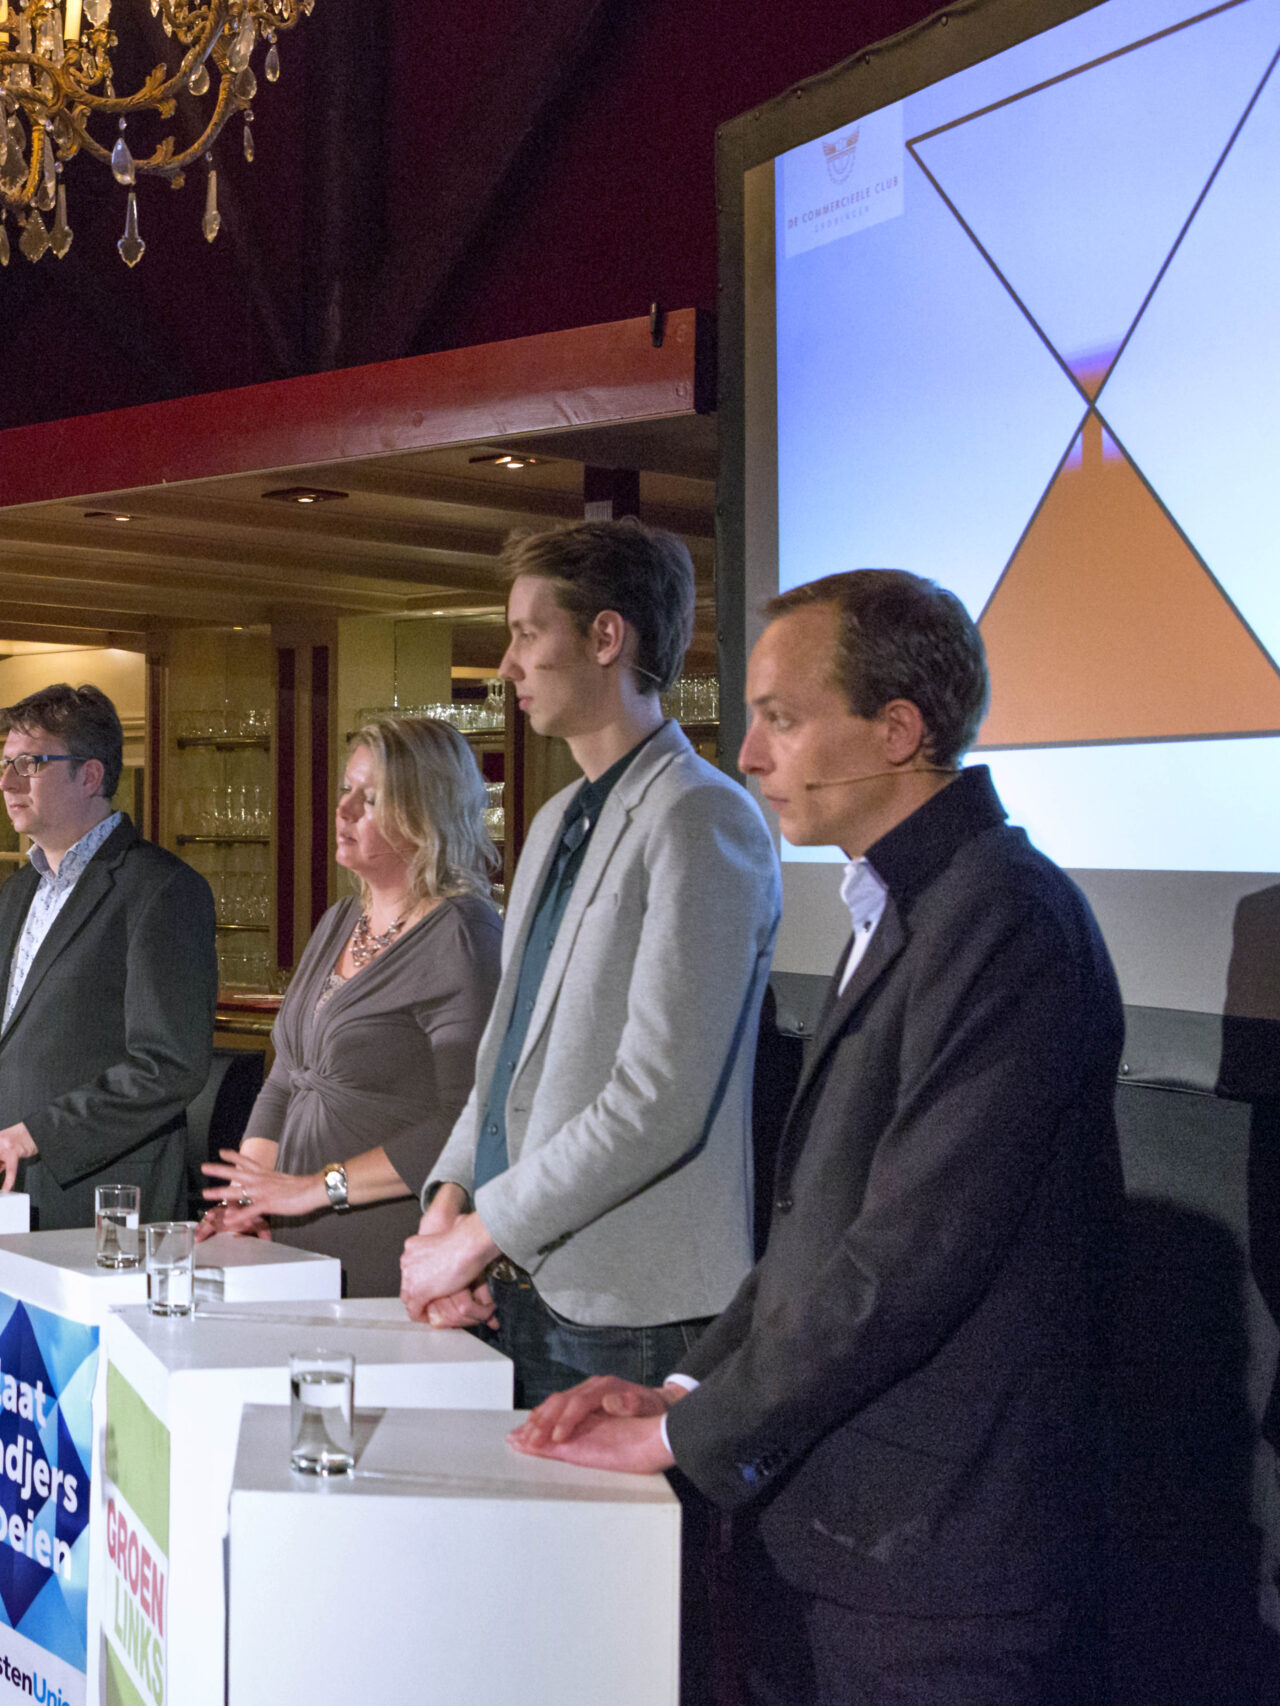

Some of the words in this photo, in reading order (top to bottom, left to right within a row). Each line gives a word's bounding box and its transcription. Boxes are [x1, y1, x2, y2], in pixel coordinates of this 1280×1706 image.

[787, 216, 799, 230] DE
[874, 175, 899, 194] CLUB
[107, 1498, 165, 1638] GROEN
[114, 1574, 164, 1706] LINKS
